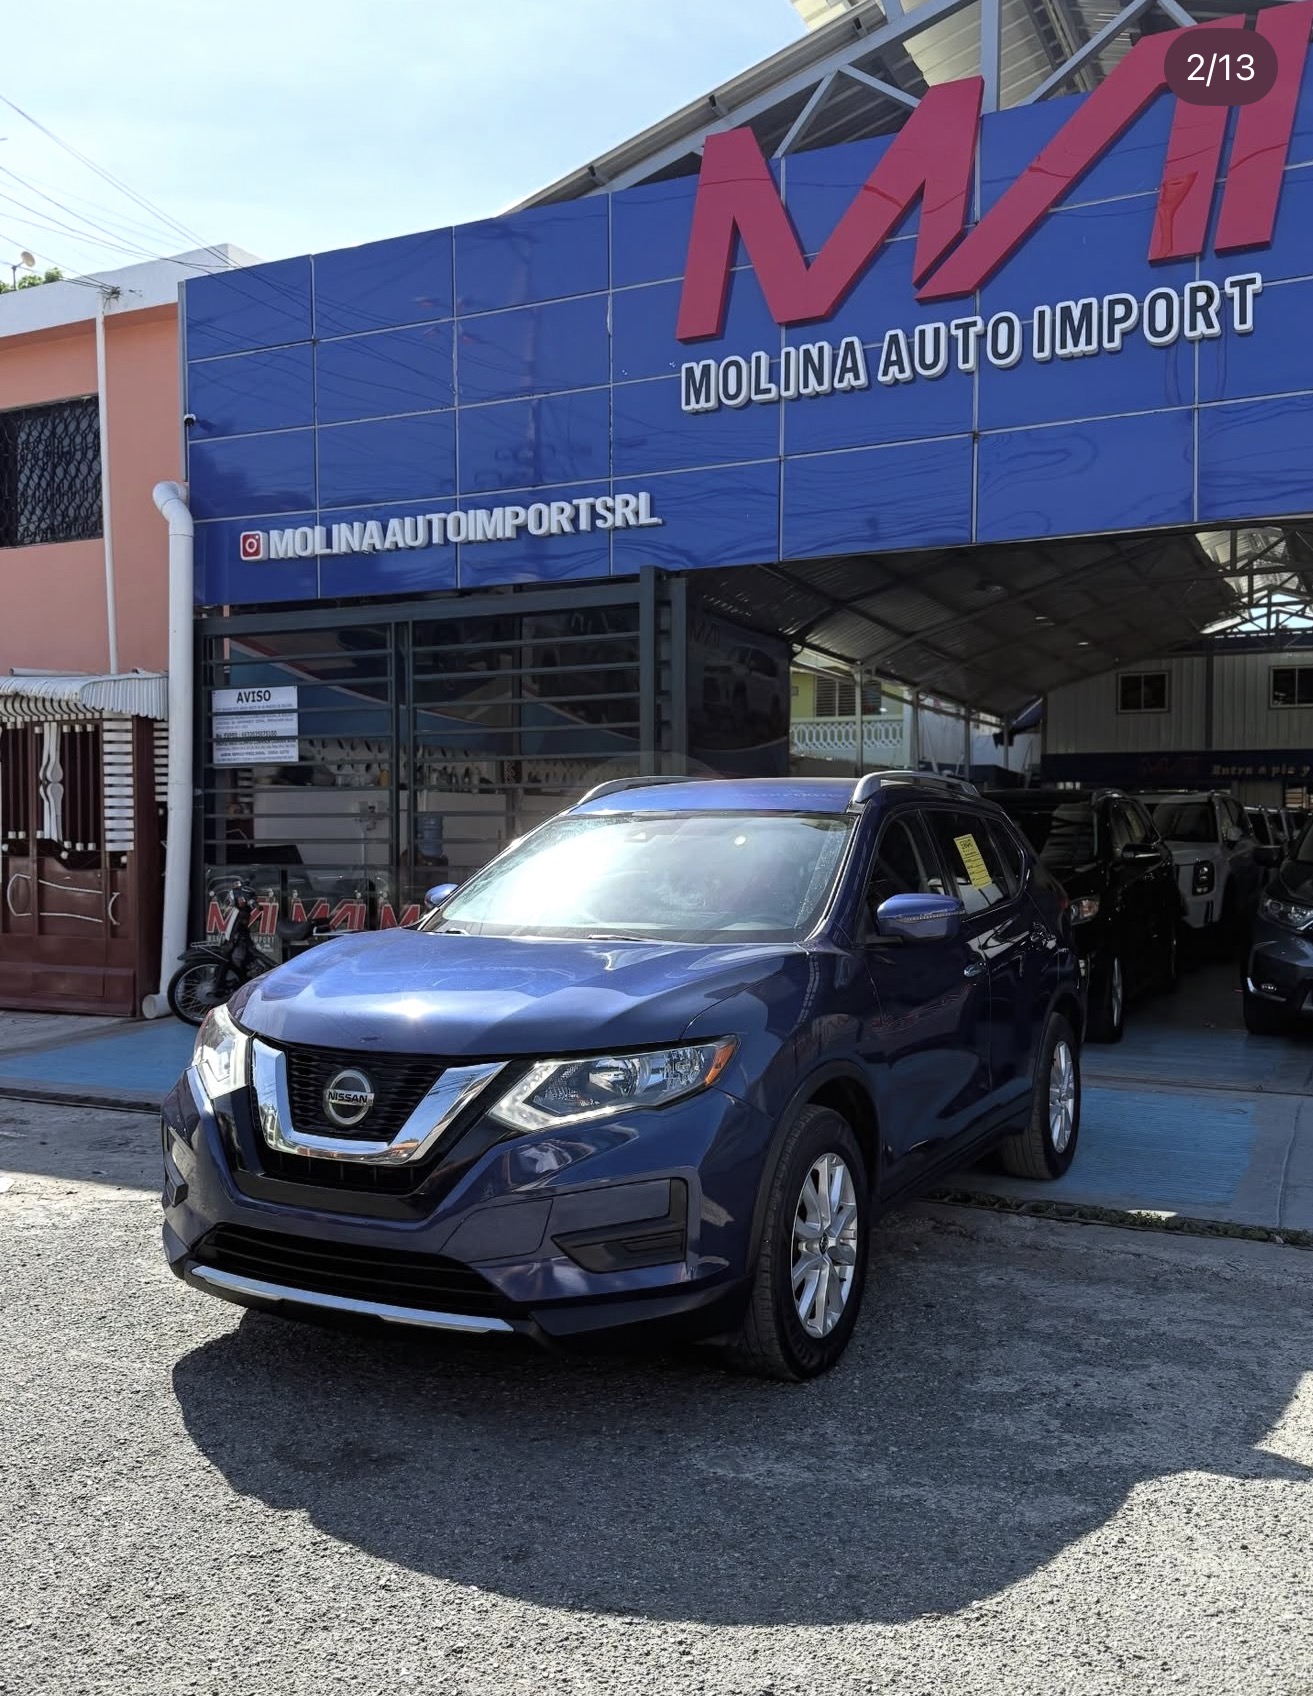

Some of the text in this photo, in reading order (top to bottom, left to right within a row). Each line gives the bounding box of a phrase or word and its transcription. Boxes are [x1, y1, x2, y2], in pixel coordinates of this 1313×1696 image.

[676, 2, 1313, 343] MAI
[681, 273, 1263, 412] MOLINA AUTO IMPORT
[269, 492, 662, 559] MOLINAAUTOIMPORTSRL
[236, 690, 271, 703] AVISO
[328, 1092, 367, 1103] NISSAN
